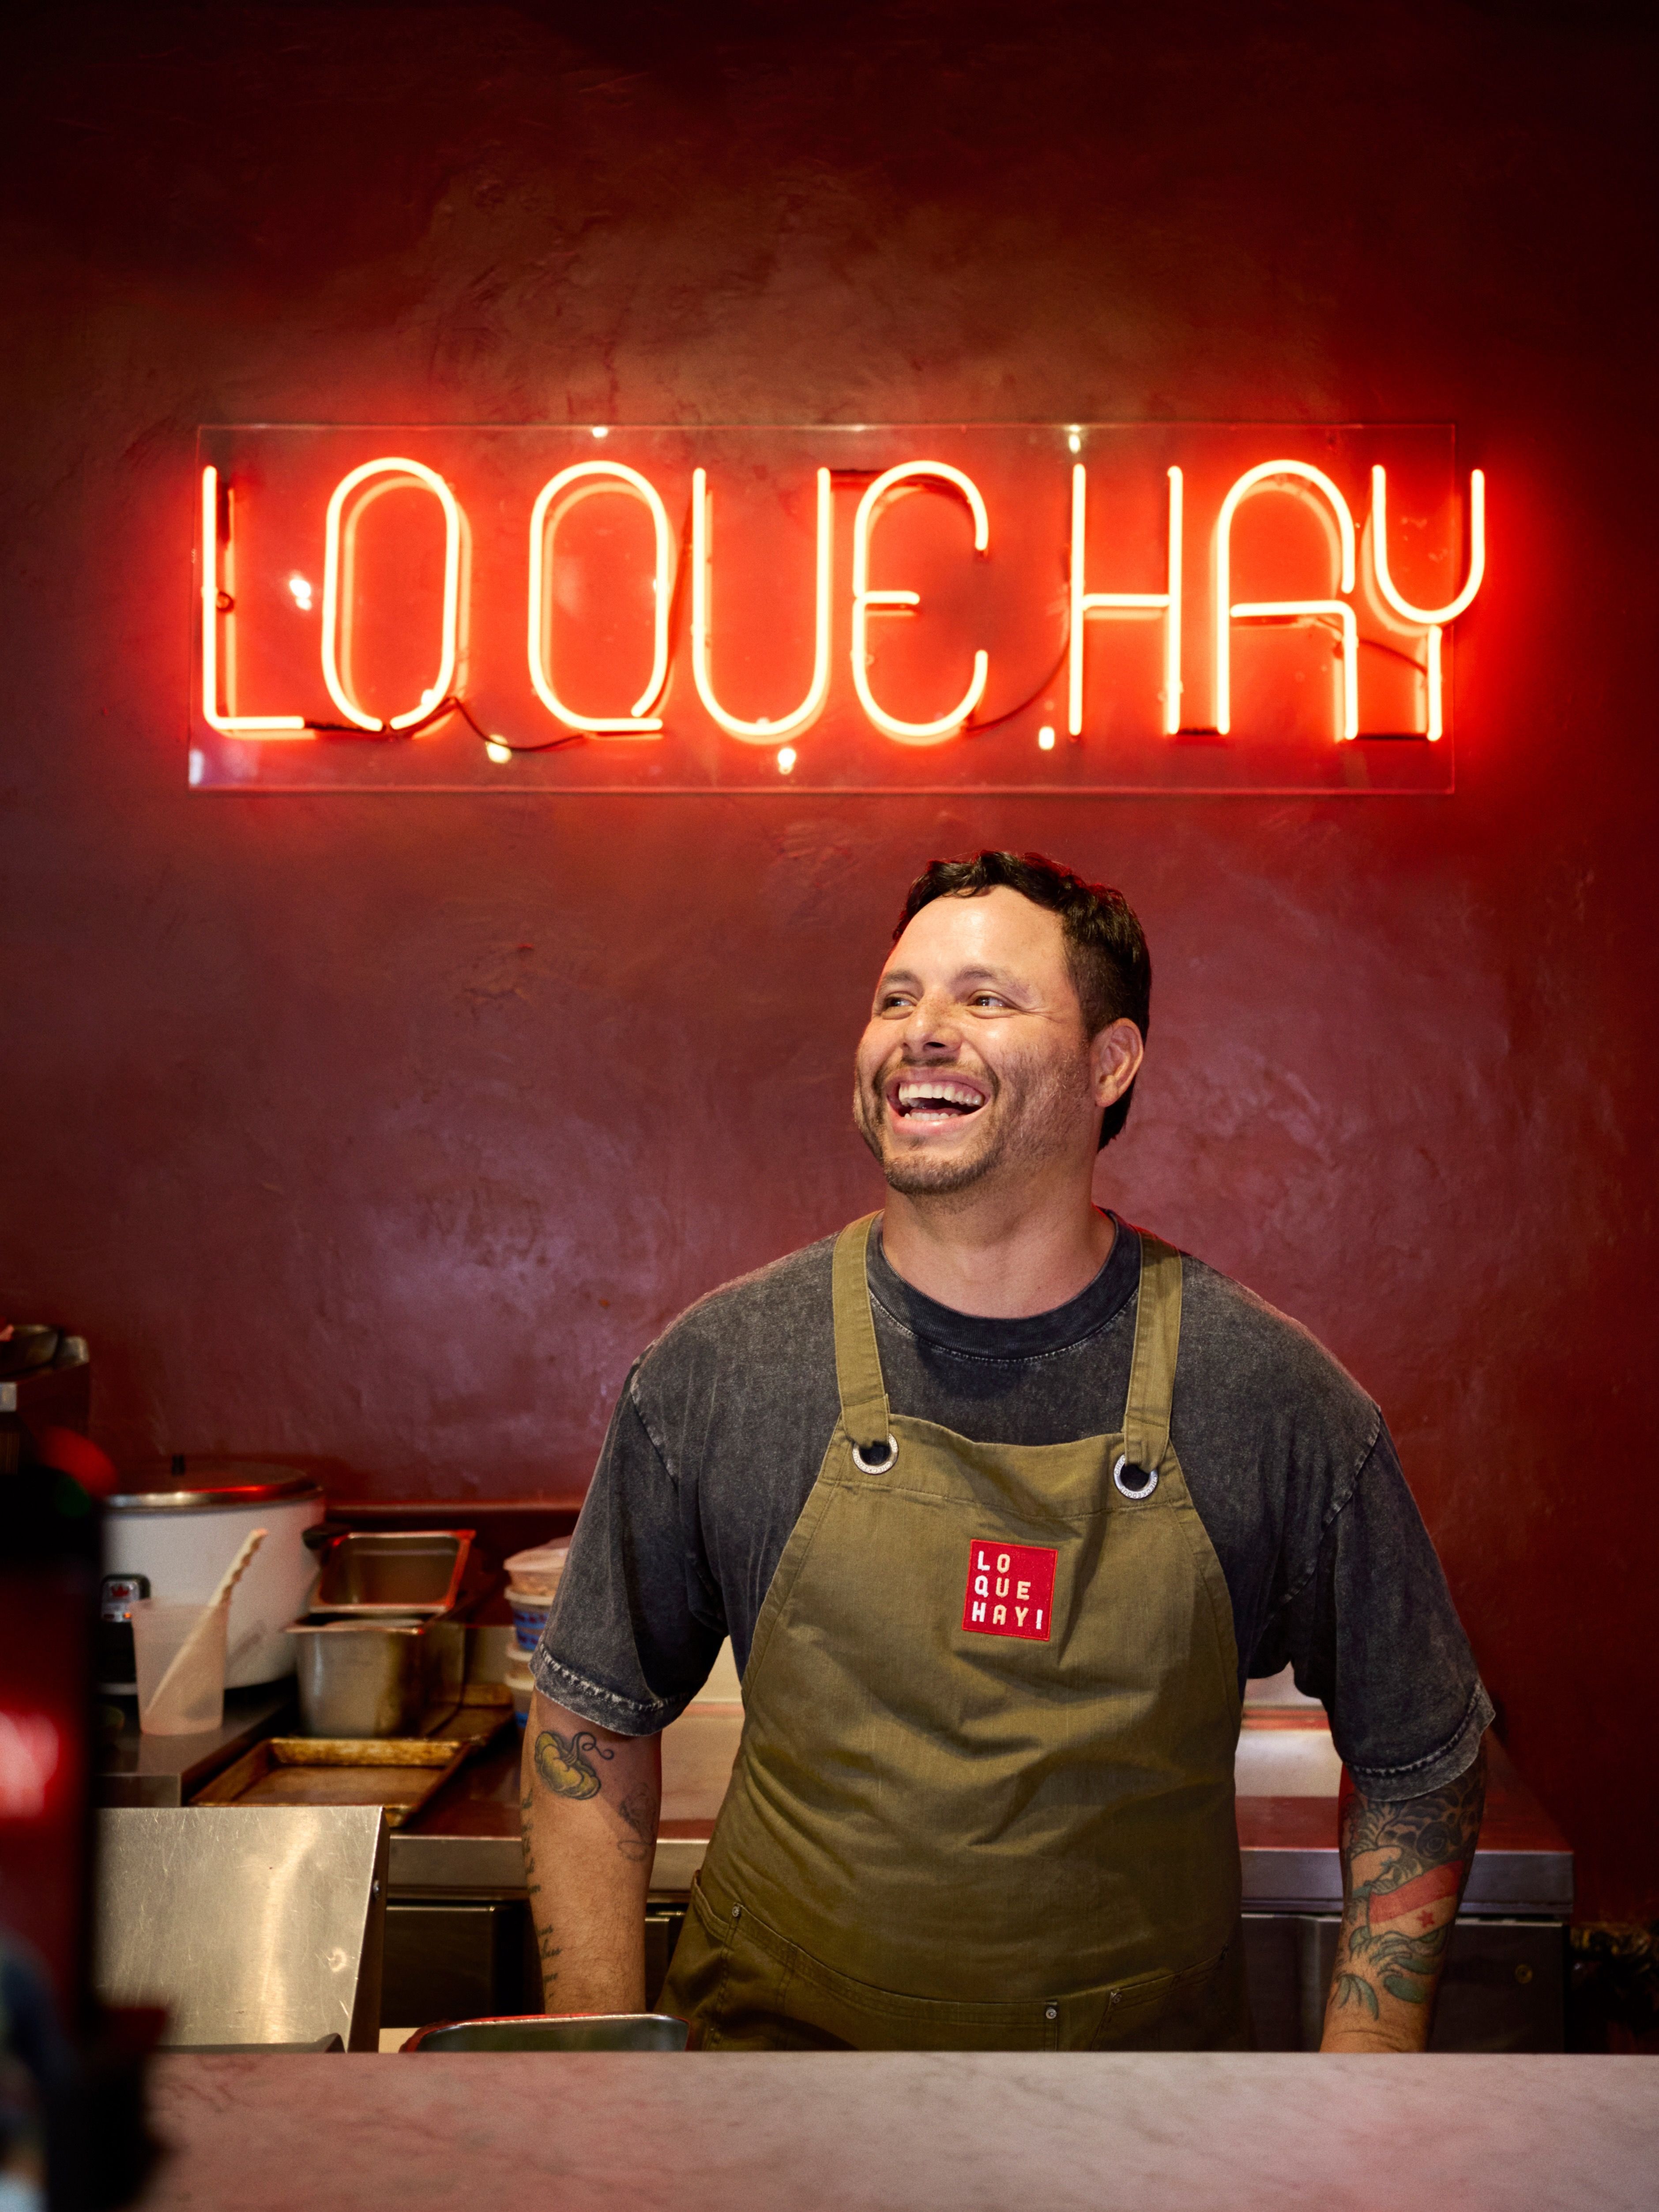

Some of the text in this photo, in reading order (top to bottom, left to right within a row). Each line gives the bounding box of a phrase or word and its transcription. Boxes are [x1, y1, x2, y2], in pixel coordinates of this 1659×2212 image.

[201, 457, 1486, 741] LO QUE HAY
[853, 1451, 892, 1473] CHECKEDOUT
[1120, 1475, 1157, 1498] CHECKEDOUT
[977, 1550, 1011, 1573] LO
[974, 1575, 1031, 1600] QUE
